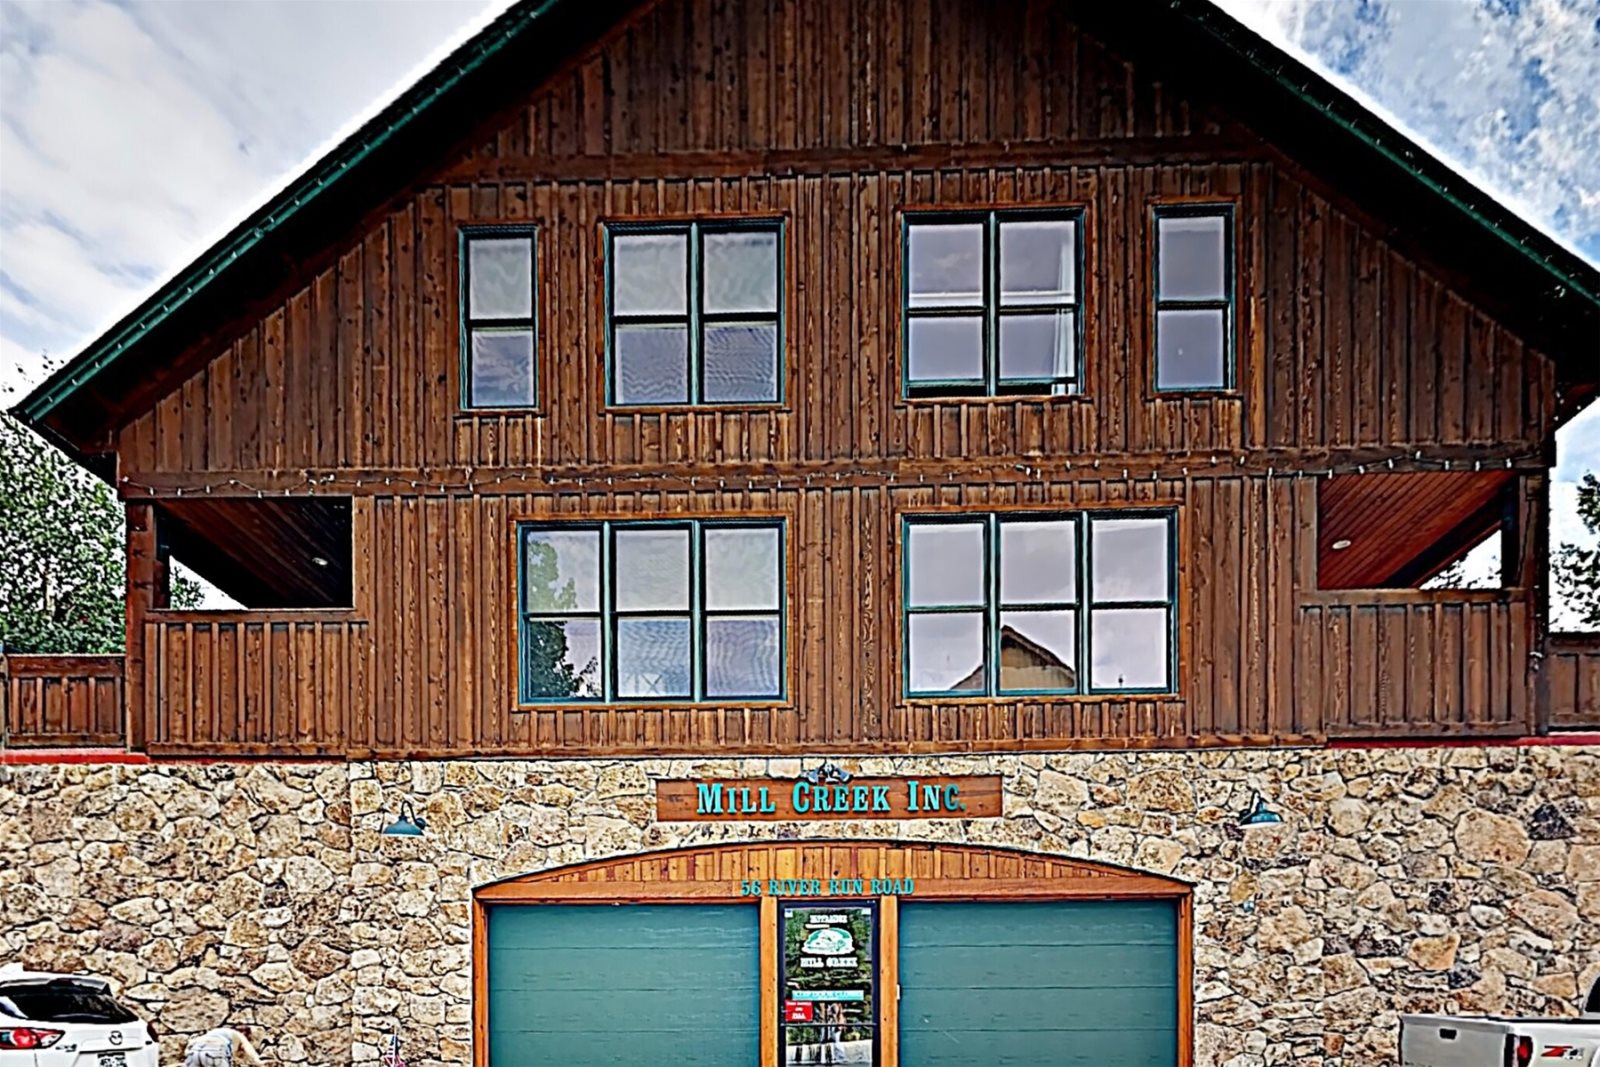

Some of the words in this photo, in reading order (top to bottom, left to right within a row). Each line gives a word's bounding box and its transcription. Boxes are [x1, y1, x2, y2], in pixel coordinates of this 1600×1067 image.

[696, 783, 776, 814] MILL
[792, 781, 890, 812] CREEK
[907, 780, 967, 811] INC.
[741, 880, 761, 896] 56
[768, 879, 821, 896] RIVER
[829, 879, 864, 896] RUN
[870, 878, 915, 895] ROAD
